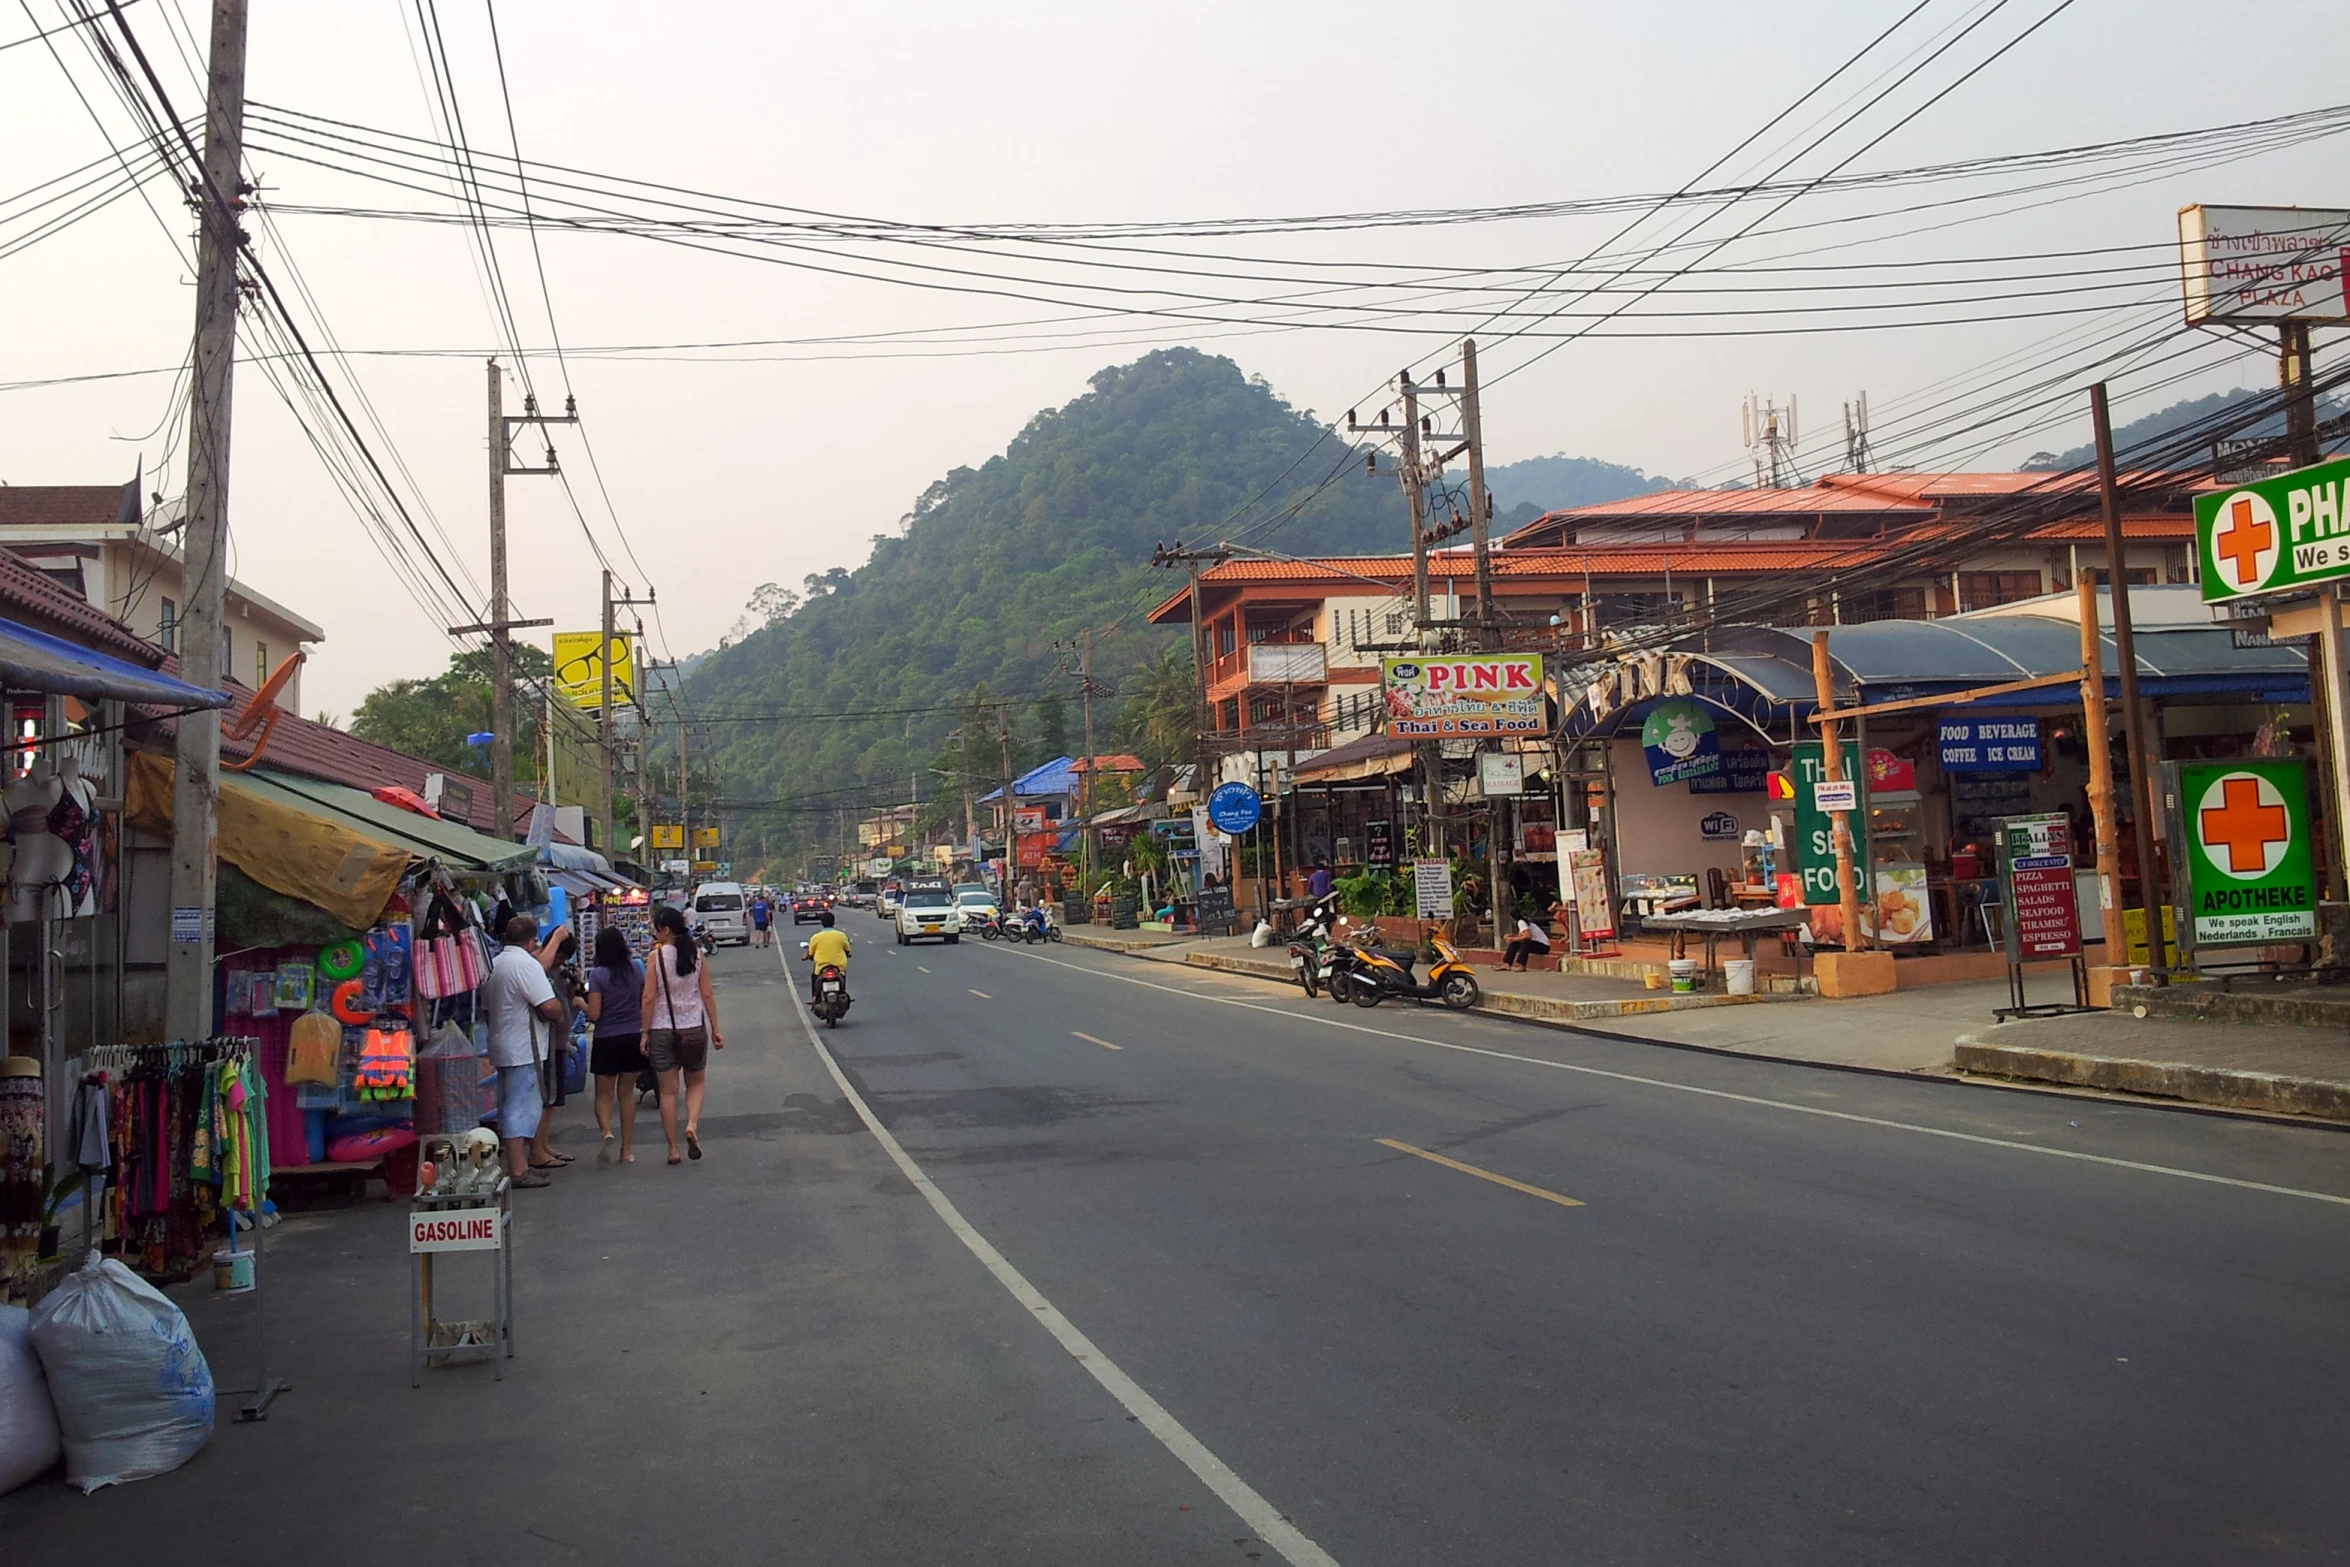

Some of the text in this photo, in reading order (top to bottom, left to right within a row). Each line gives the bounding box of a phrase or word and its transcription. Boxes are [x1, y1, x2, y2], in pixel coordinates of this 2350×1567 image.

[2209, 260, 2334, 281] CHANG KAO
[2239, 290, 2307, 306] PLAZA
[2296, 547, 2328, 569] We
[1426, 663, 1533, 690] PINK
[1414, 701, 1485, 717] อาหารไทย
[1491, 703, 1501, 713] &
[1396, 718, 1538, 733] Thai & Sea Food
[1940, 724, 2037, 740] FOOD BEVERAGE
[1942, 746, 2036, 763] COFFEE ICE CREAM
[2012, 831, 2065, 845] ITALIAN
[1023, 851, 1041, 860] ATM
[2013, 846, 2066, 856] Restaurant
[2016, 872, 2043, 882] PIZZA
[909, 881, 942, 889] TAXI
[2017, 882, 2070, 894] SPAGHETTI
[2018, 895, 2055, 906] SALADS
[2203, 886, 2306, 911] APOTHEKE
[2020, 906, 2064, 918] SEAFOOD
[2208, 914, 2300, 929] We speak English
[2022, 930, 2071, 942] ESPRESSO
[2199, 928, 2257, 942] Nederlands
[415, 1219, 493, 1242] GASOLINE
